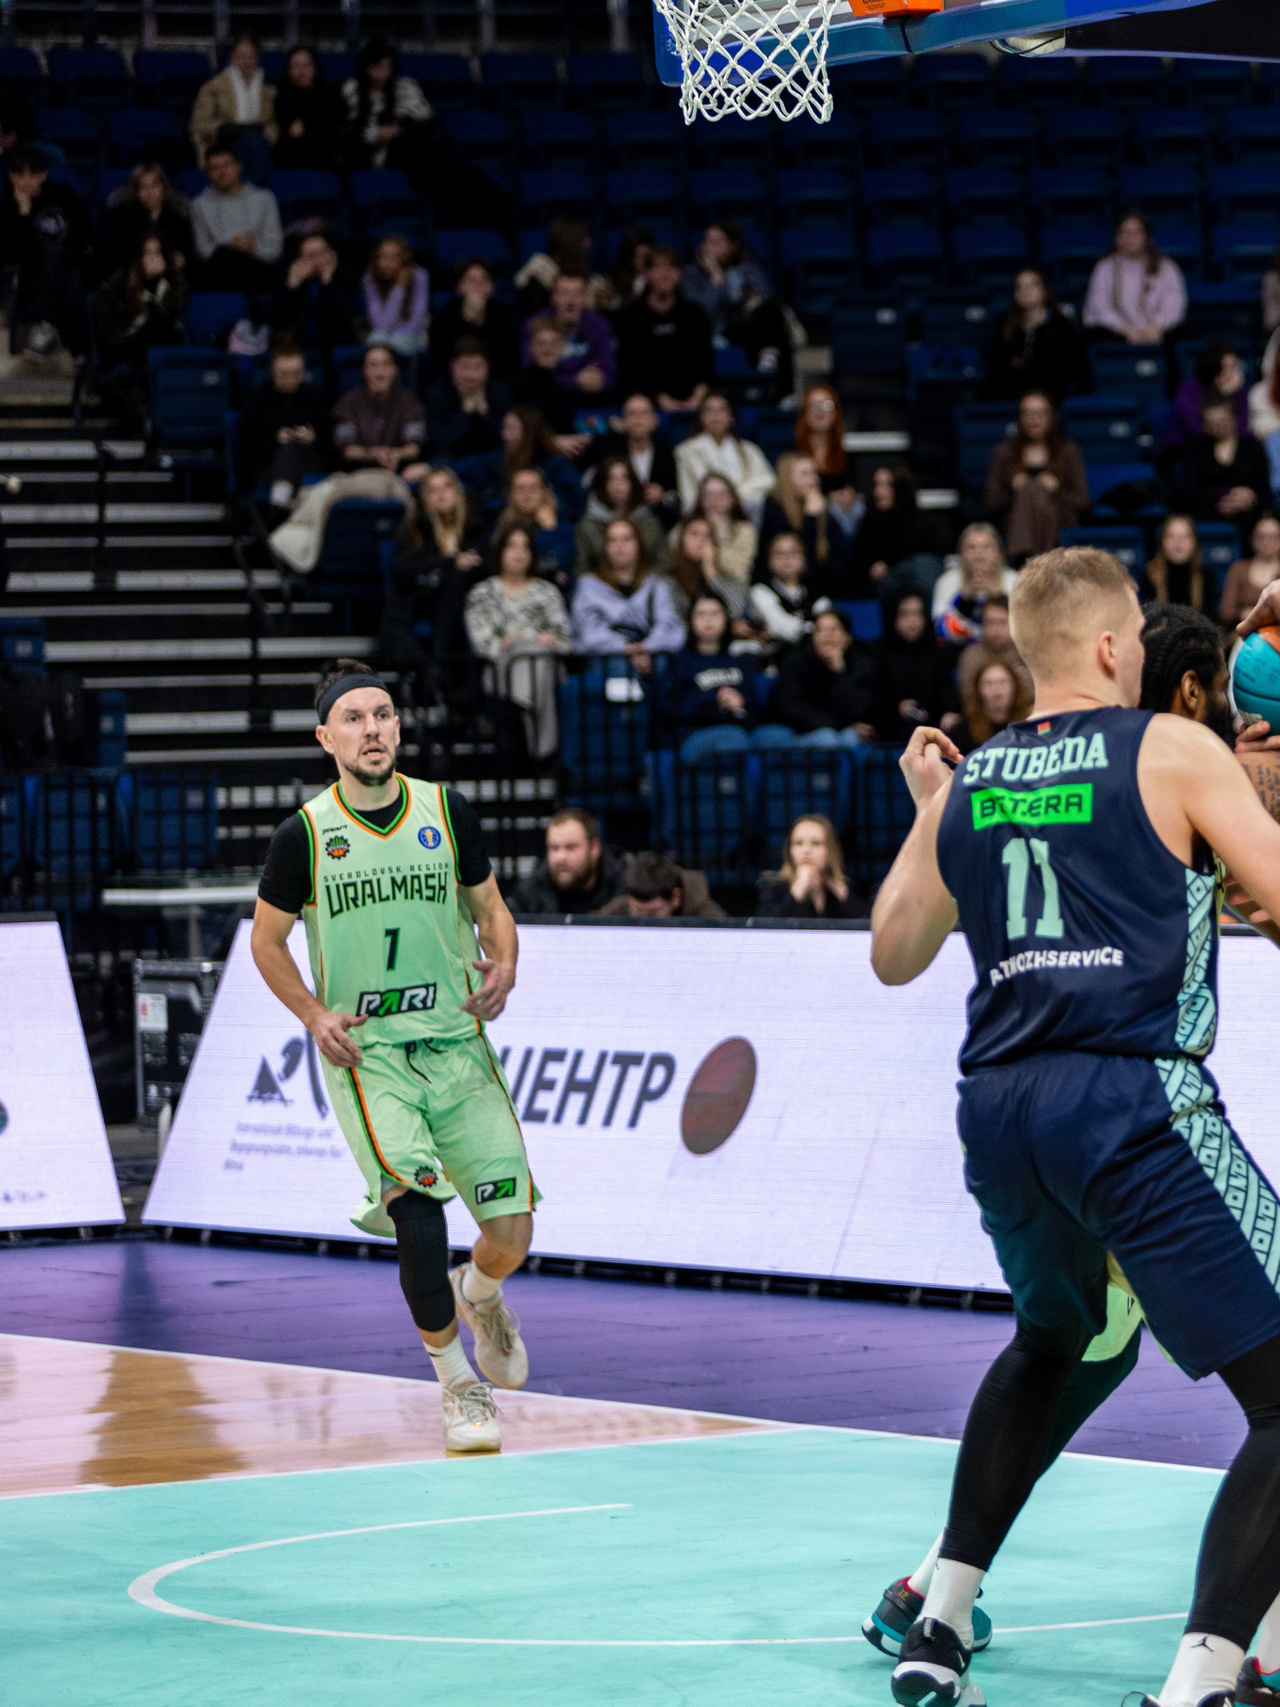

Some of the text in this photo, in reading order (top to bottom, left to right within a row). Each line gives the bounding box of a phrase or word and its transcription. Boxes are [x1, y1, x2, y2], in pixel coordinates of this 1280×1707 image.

[963, 732, 1109, 784] STUBEDA
[409, 862, 449, 872] REGION
[1002, 838, 1064, 940] 11
[324, 871, 448, 919] URALMASH
